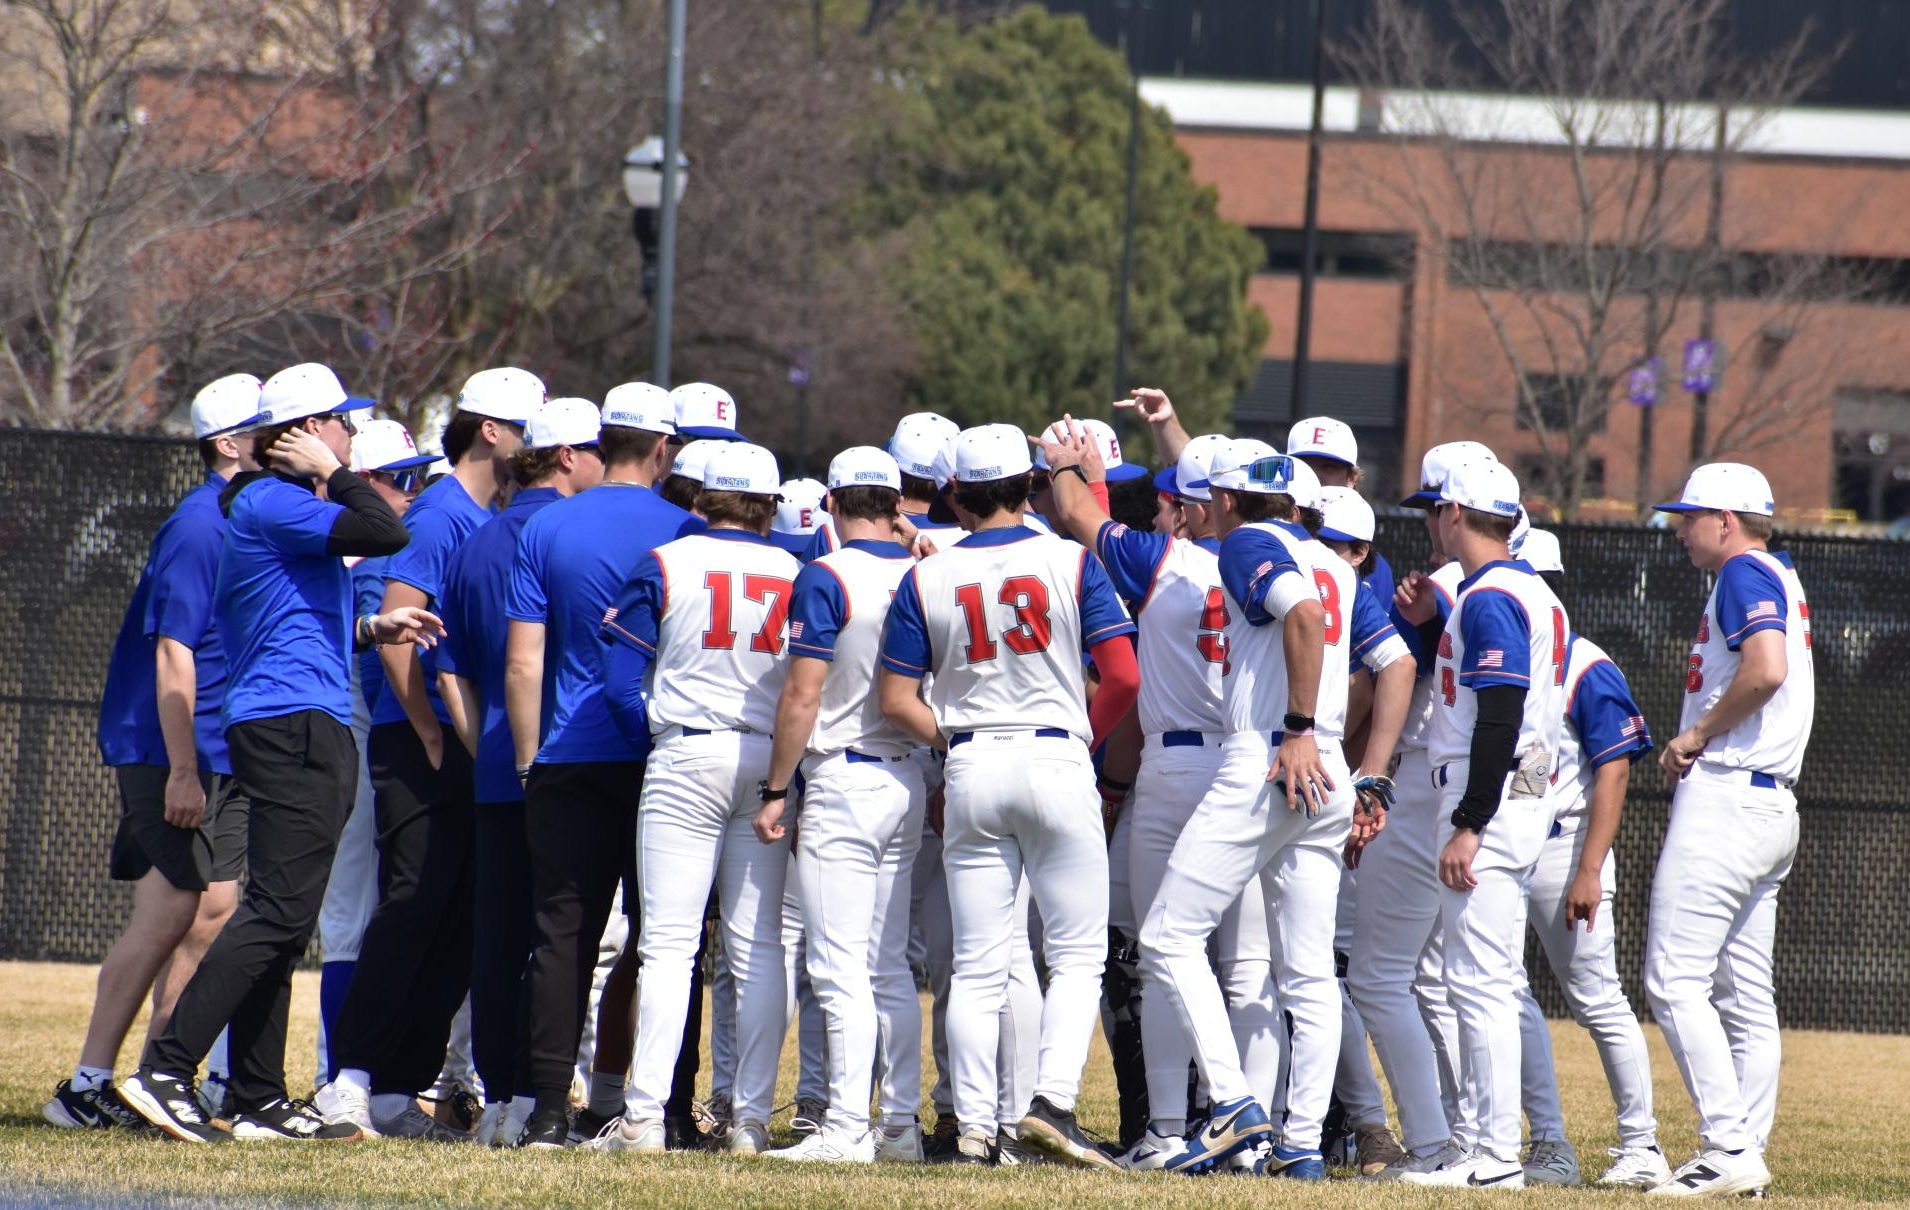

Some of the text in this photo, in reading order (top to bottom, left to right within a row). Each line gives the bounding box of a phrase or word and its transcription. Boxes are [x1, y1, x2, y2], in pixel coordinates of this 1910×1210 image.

[716, 400, 728, 421] E
[1312, 427, 1326, 445] E
[1110, 440, 1119, 459] E
[800, 507, 813, 528] E
[702, 571, 794, 655] 17
[955, 575, 1051, 664] 13
[1676, 1164, 1721, 1189] N
